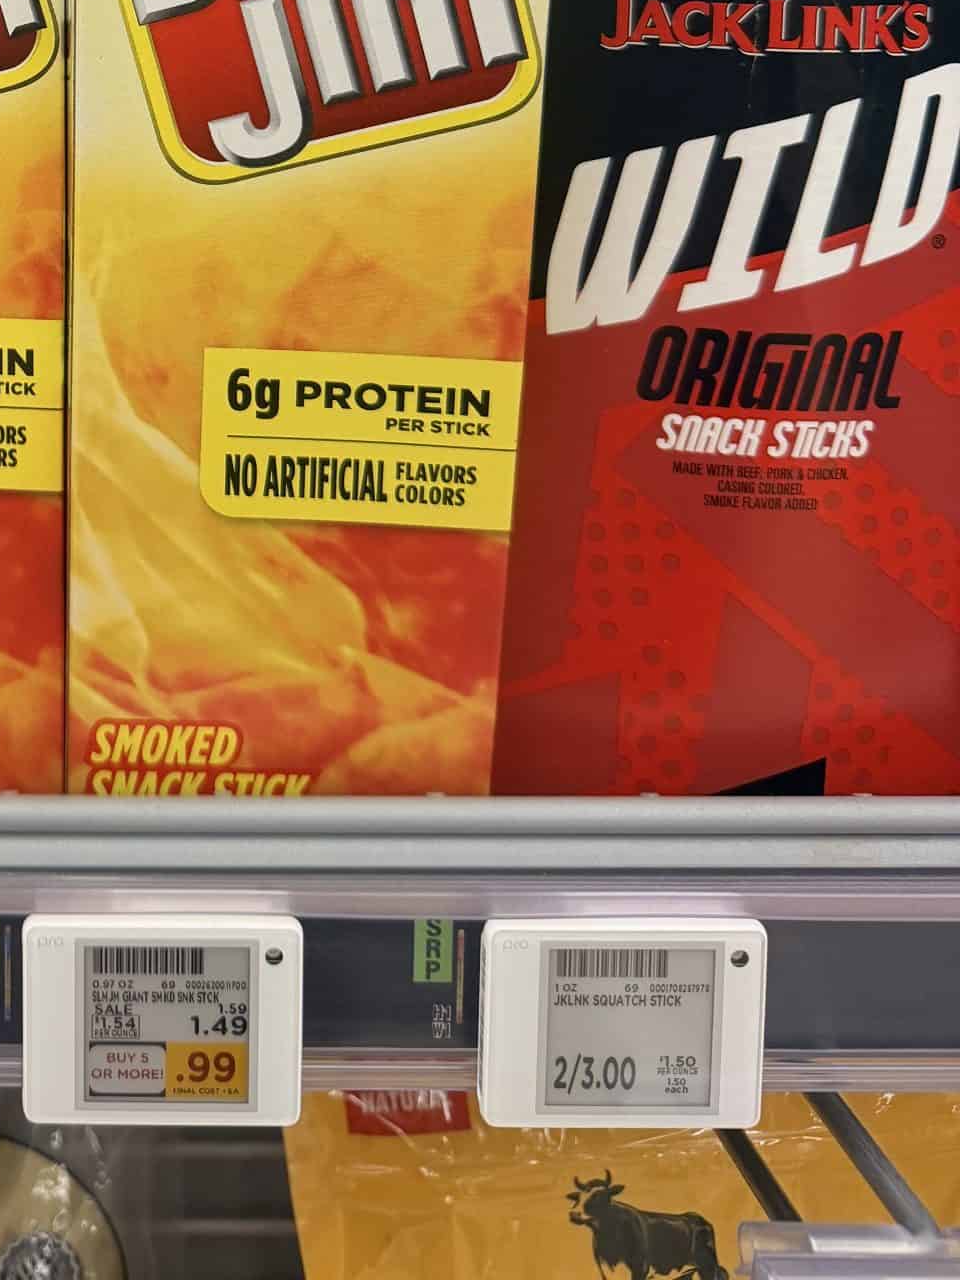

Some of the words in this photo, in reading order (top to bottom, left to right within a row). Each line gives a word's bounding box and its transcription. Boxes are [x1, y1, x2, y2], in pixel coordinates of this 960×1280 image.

[762, 0, 932, 55] LINK'S
[545, 62, 960, 336] WILD
[637, 325, 904, 411] ORIGINAL
[227, 367, 280, 419] 6g
[295, 379, 491, 417] PROTEIN
[385, 417, 426, 432] PER
[430, 419, 491, 437] STICK
[656, 412, 768, 457] SNACK
[767, 419, 877, 459] STICKS
[224, 453, 258, 497] NO
[263, 454, 388, 503] ARTIFICIAL
[395, 461, 478, 485] FLAVORS
[672, 461, 702, 476] MADE
[706, 463, 733, 478] WITH
[395, 484, 466, 506] COLORS
[717, 480, 755, 494] CASING
[703, 494, 740, 508] SMOKE
[742, 496, 782, 509] FLAVOR
[785, 498, 817, 511] ADDED
[91, 723, 238, 765] SMOKED
[91, 769, 207, 797] SNACK
[213, 772, 310, 799] STICK
[117, 980, 134, 989] OZ
[563, 984, 578, 993] OZ
[624, 984, 639, 993] 69
[123, 991, 148, 1003] GIANT
[152, 991, 175, 1003] SMKD
[177, 991, 195, 1003] SNK
[197, 991, 220, 1003] STCK
[554, 995, 590, 1007] JKLNK
[593, 995, 647, 1007] SQUATCH
[650, 995, 682, 1007] STICK
[95, 1004, 133, 1016] SALE
[218, 1003, 247, 1015] 1.59
[190, 1015, 248, 1036] 1.49
[106, 1052, 137, 1064] BUY
[141, 1052, 149, 1064] 5
[176, 1051, 236, 1083] .99
[92, 1069, 113, 1080] OR
[117, 1069, 164, 1080] MORE!
[553, 1053, 636, 1095] 2/3.00
[665, 1086, 689, 1094] each
